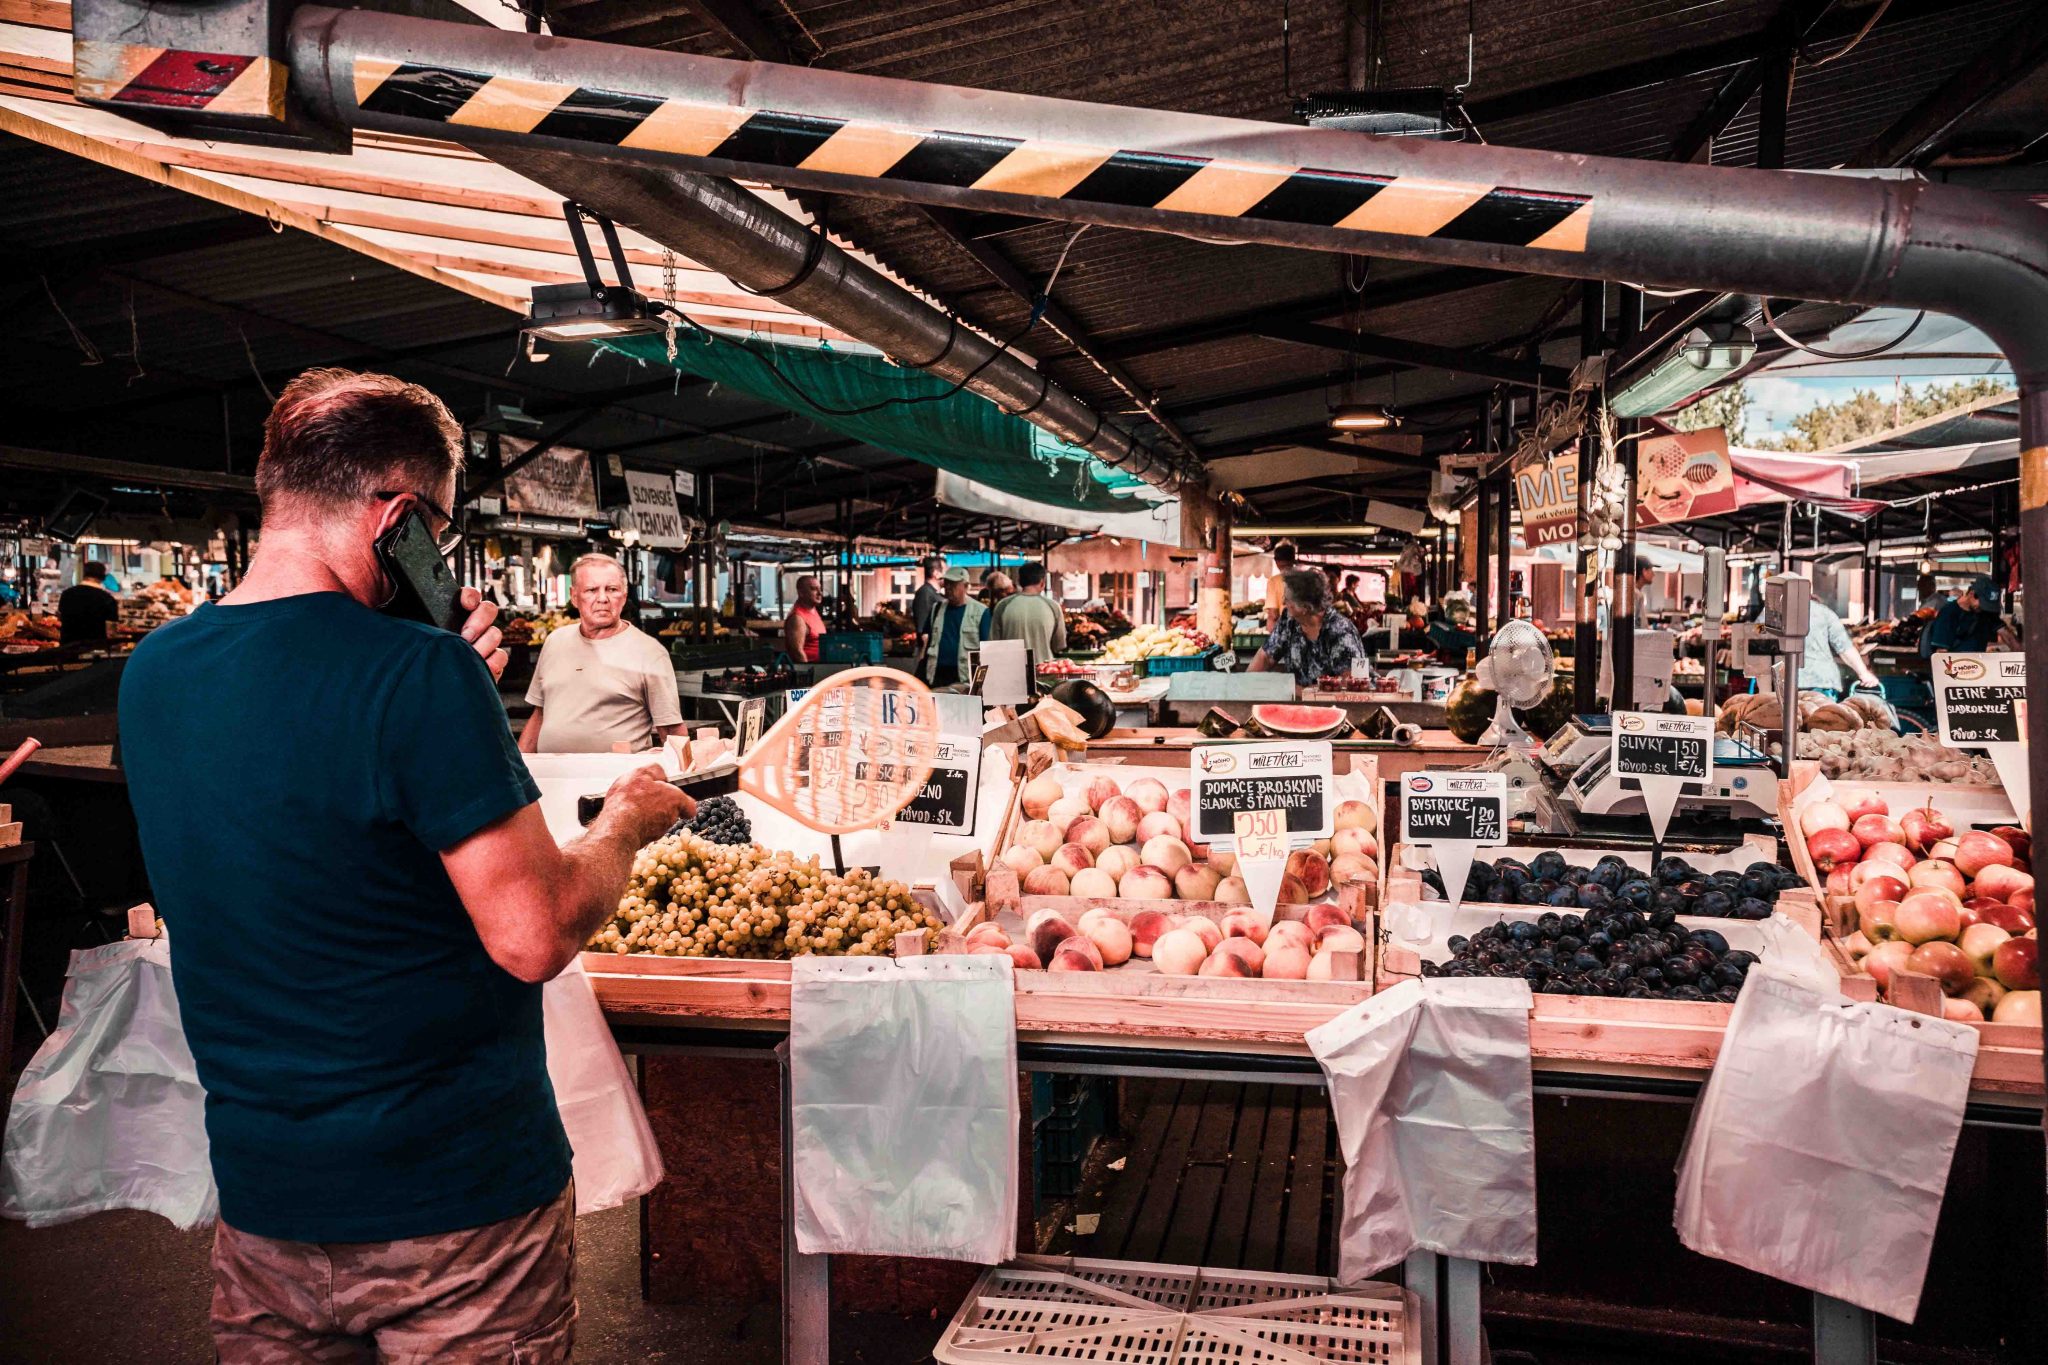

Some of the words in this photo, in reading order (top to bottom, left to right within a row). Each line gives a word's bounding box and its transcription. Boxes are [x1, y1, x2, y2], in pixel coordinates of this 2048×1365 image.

[633, 484, 673, 507] SLOVENSKÉ
[1536, 511, 1547, 520] od
[637, 511, 679, 537] ZEMIAKY
[1948, 686, 1991, 700] LETNÉ
[1620, 736, 1664, 752] SLIVKY
[1256, 778, 1323, 795] BROSKYNE
[1410, 797, 1474, 812] BYSTRICKÉ
[1410, 813, 1451, 826] SLIVKY
